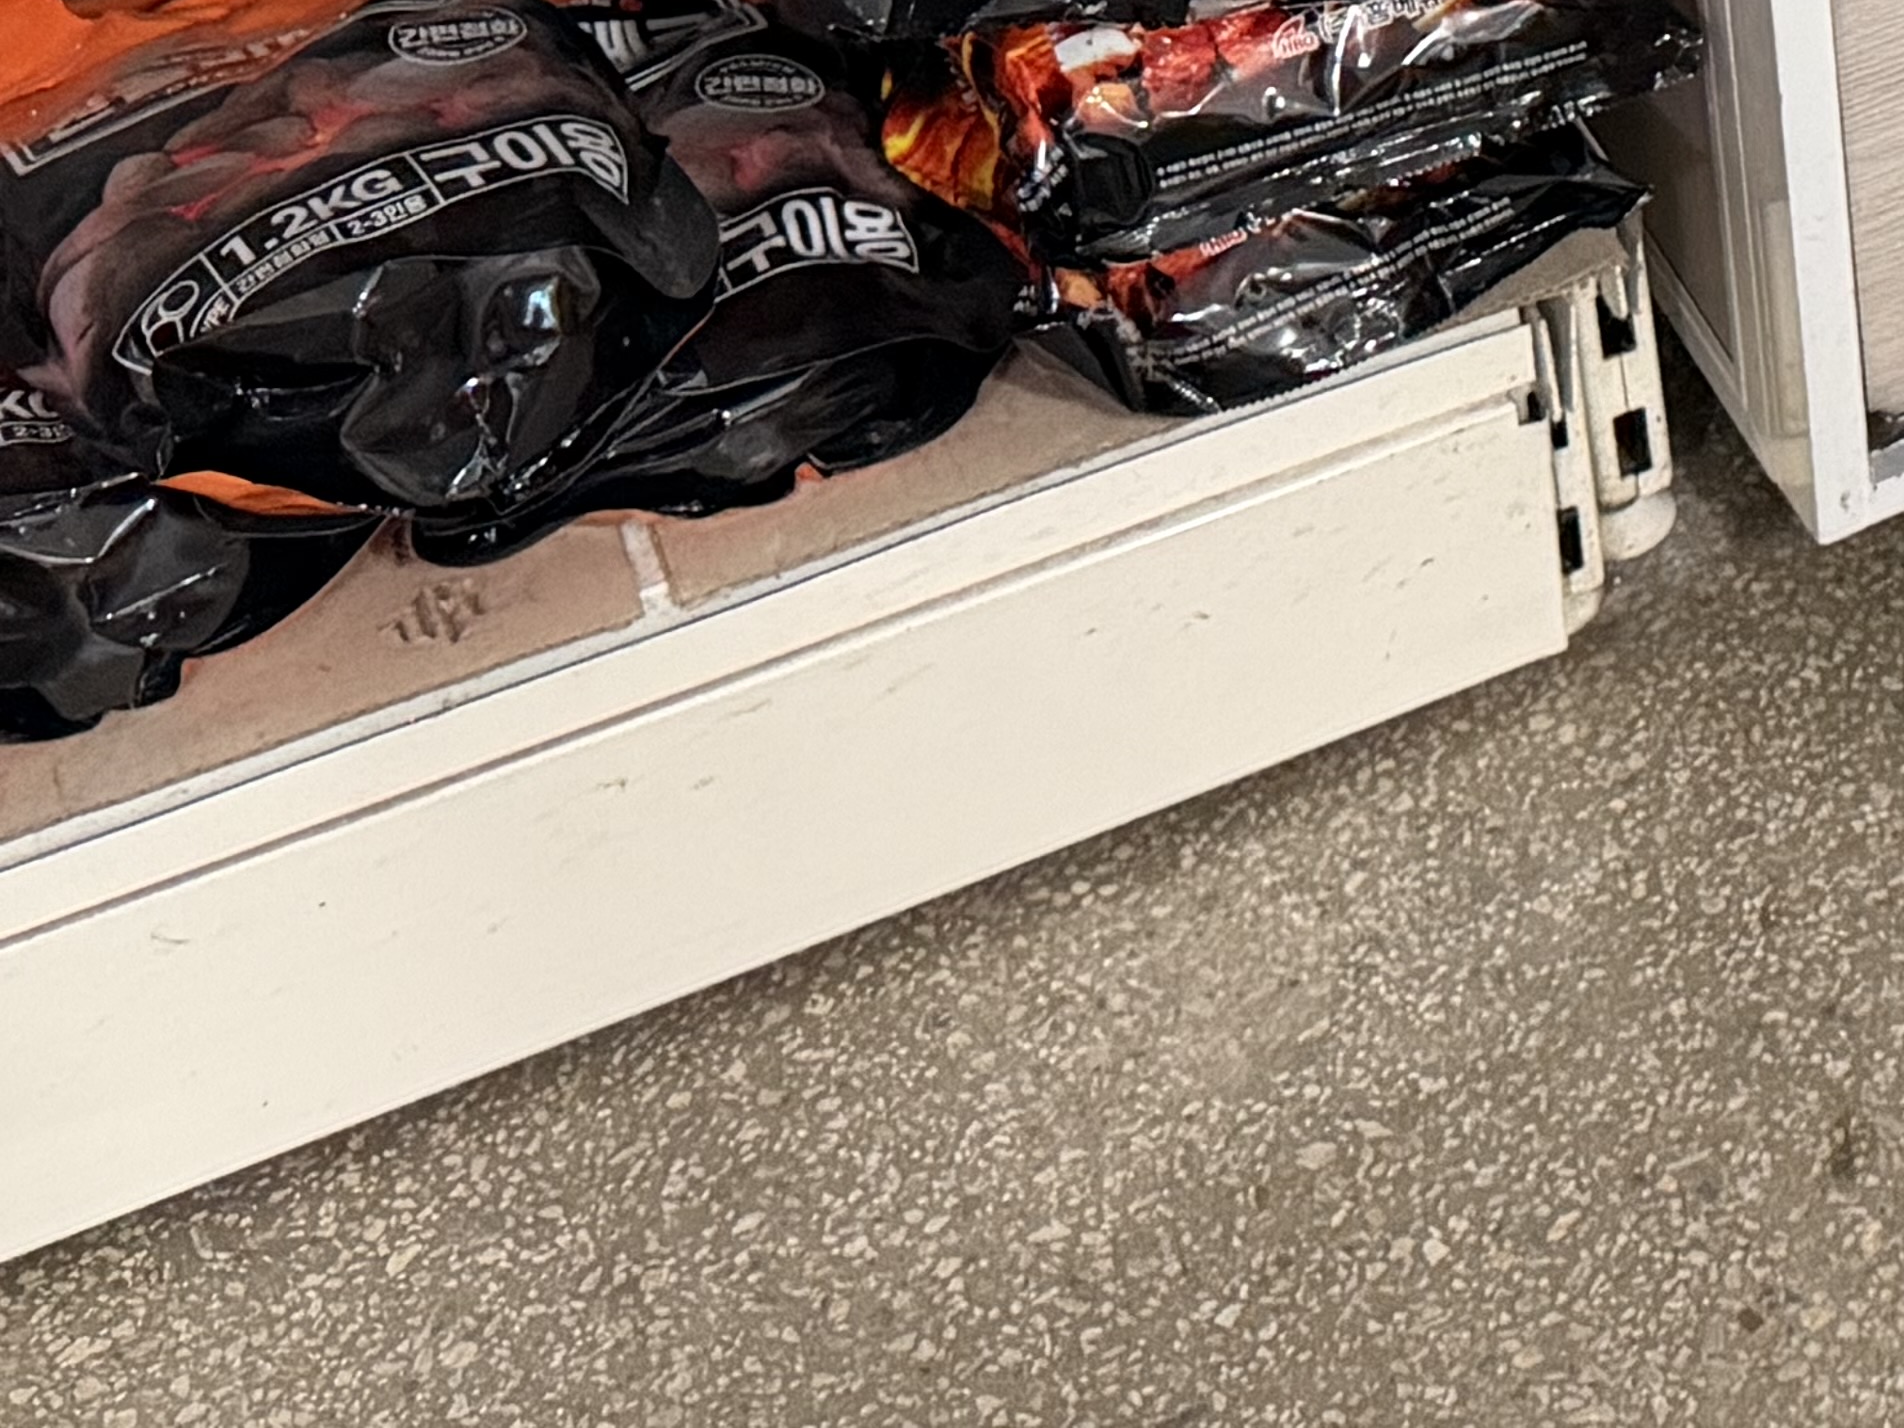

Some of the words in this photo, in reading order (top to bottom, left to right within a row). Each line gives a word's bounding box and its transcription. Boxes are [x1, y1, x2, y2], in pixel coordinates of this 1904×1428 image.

[220, 167, 404, 270] 1.2KG
[433, 118, 622, 190] 구이용
[345, 194, 428, 239] 2-3인용
[722, 198, 916, 272] 구이용
